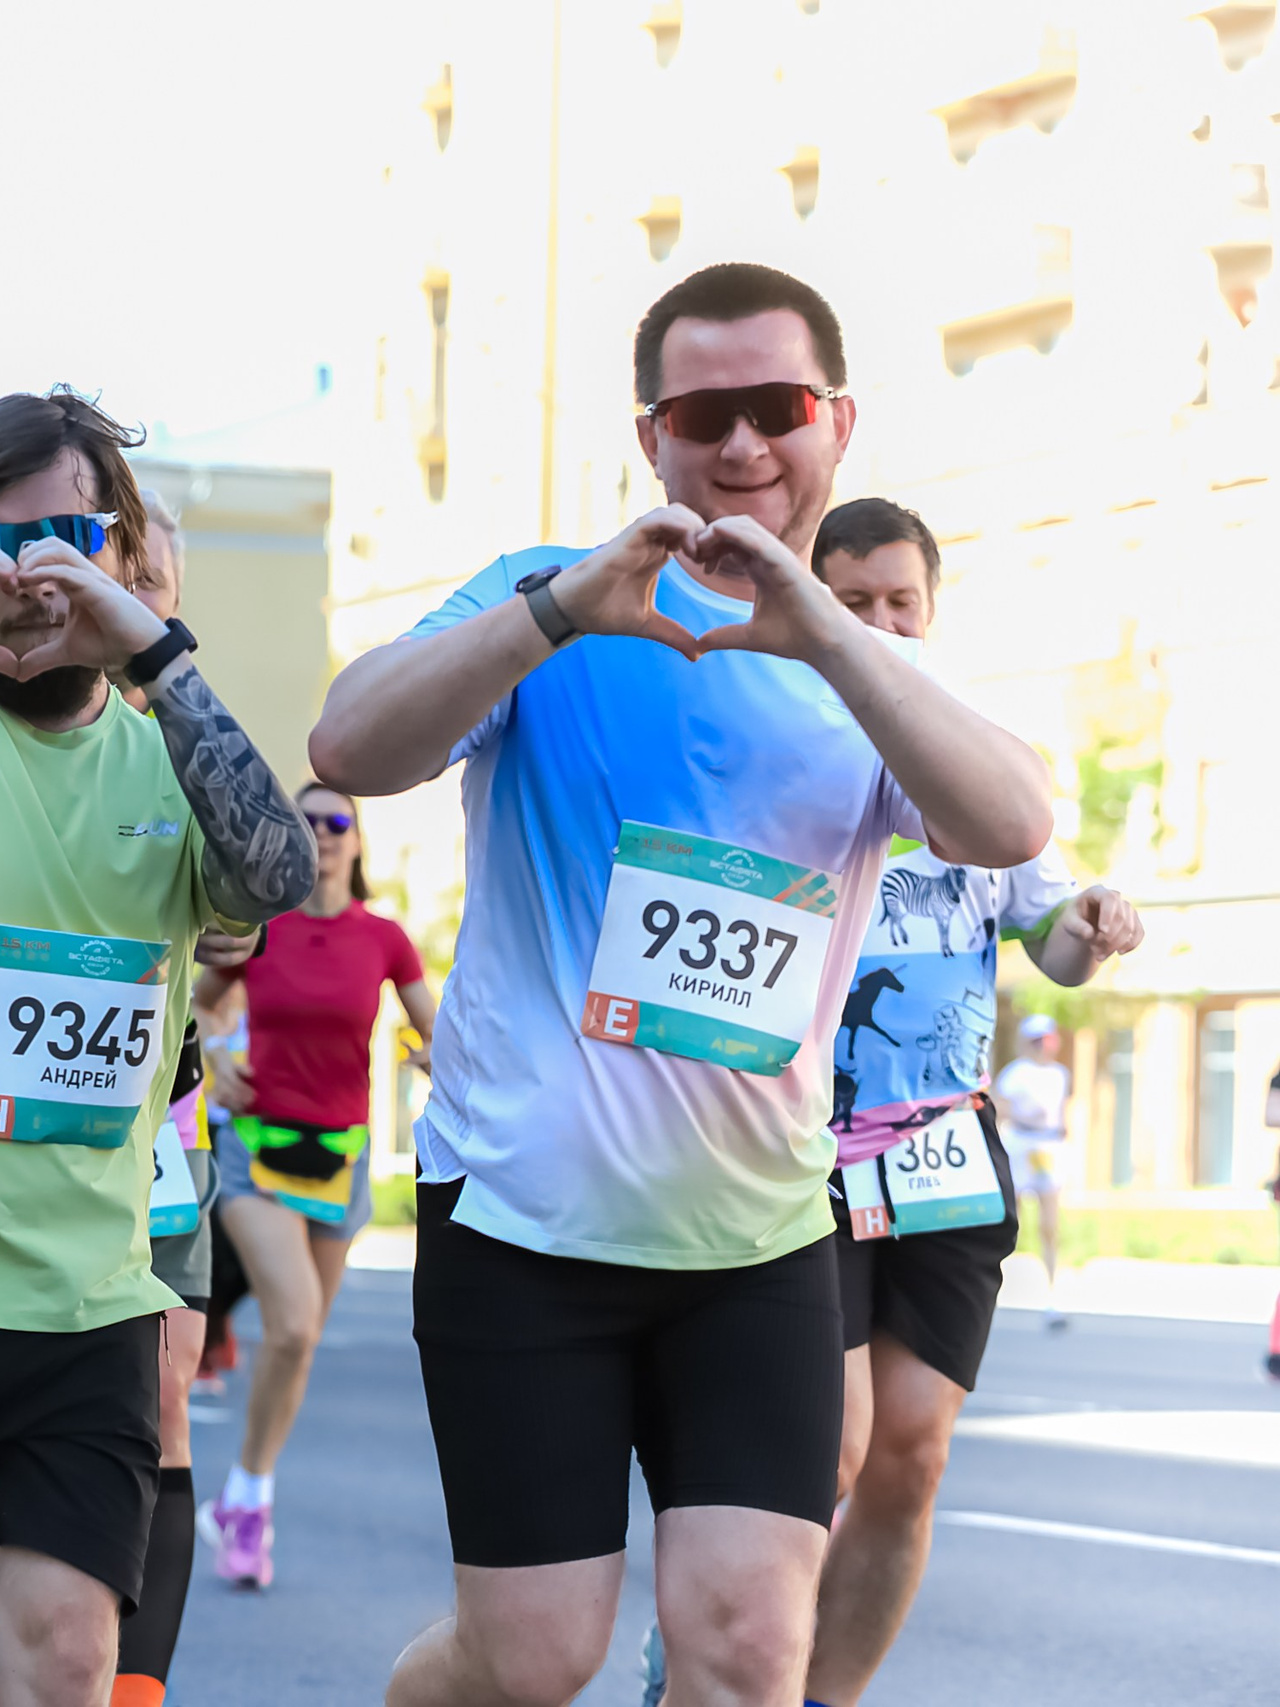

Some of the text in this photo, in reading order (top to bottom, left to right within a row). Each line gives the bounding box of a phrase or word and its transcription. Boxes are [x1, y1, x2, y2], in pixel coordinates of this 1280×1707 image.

[642, 899, 799, 990] 9337
[668, 972, 752, 1009] КИРИЛЛ
[8, 996, 156, 1067] 9345
[39, 1066, 118, 1090] АНДРЕЙ
[896, 1128, 967, 1173] 366
